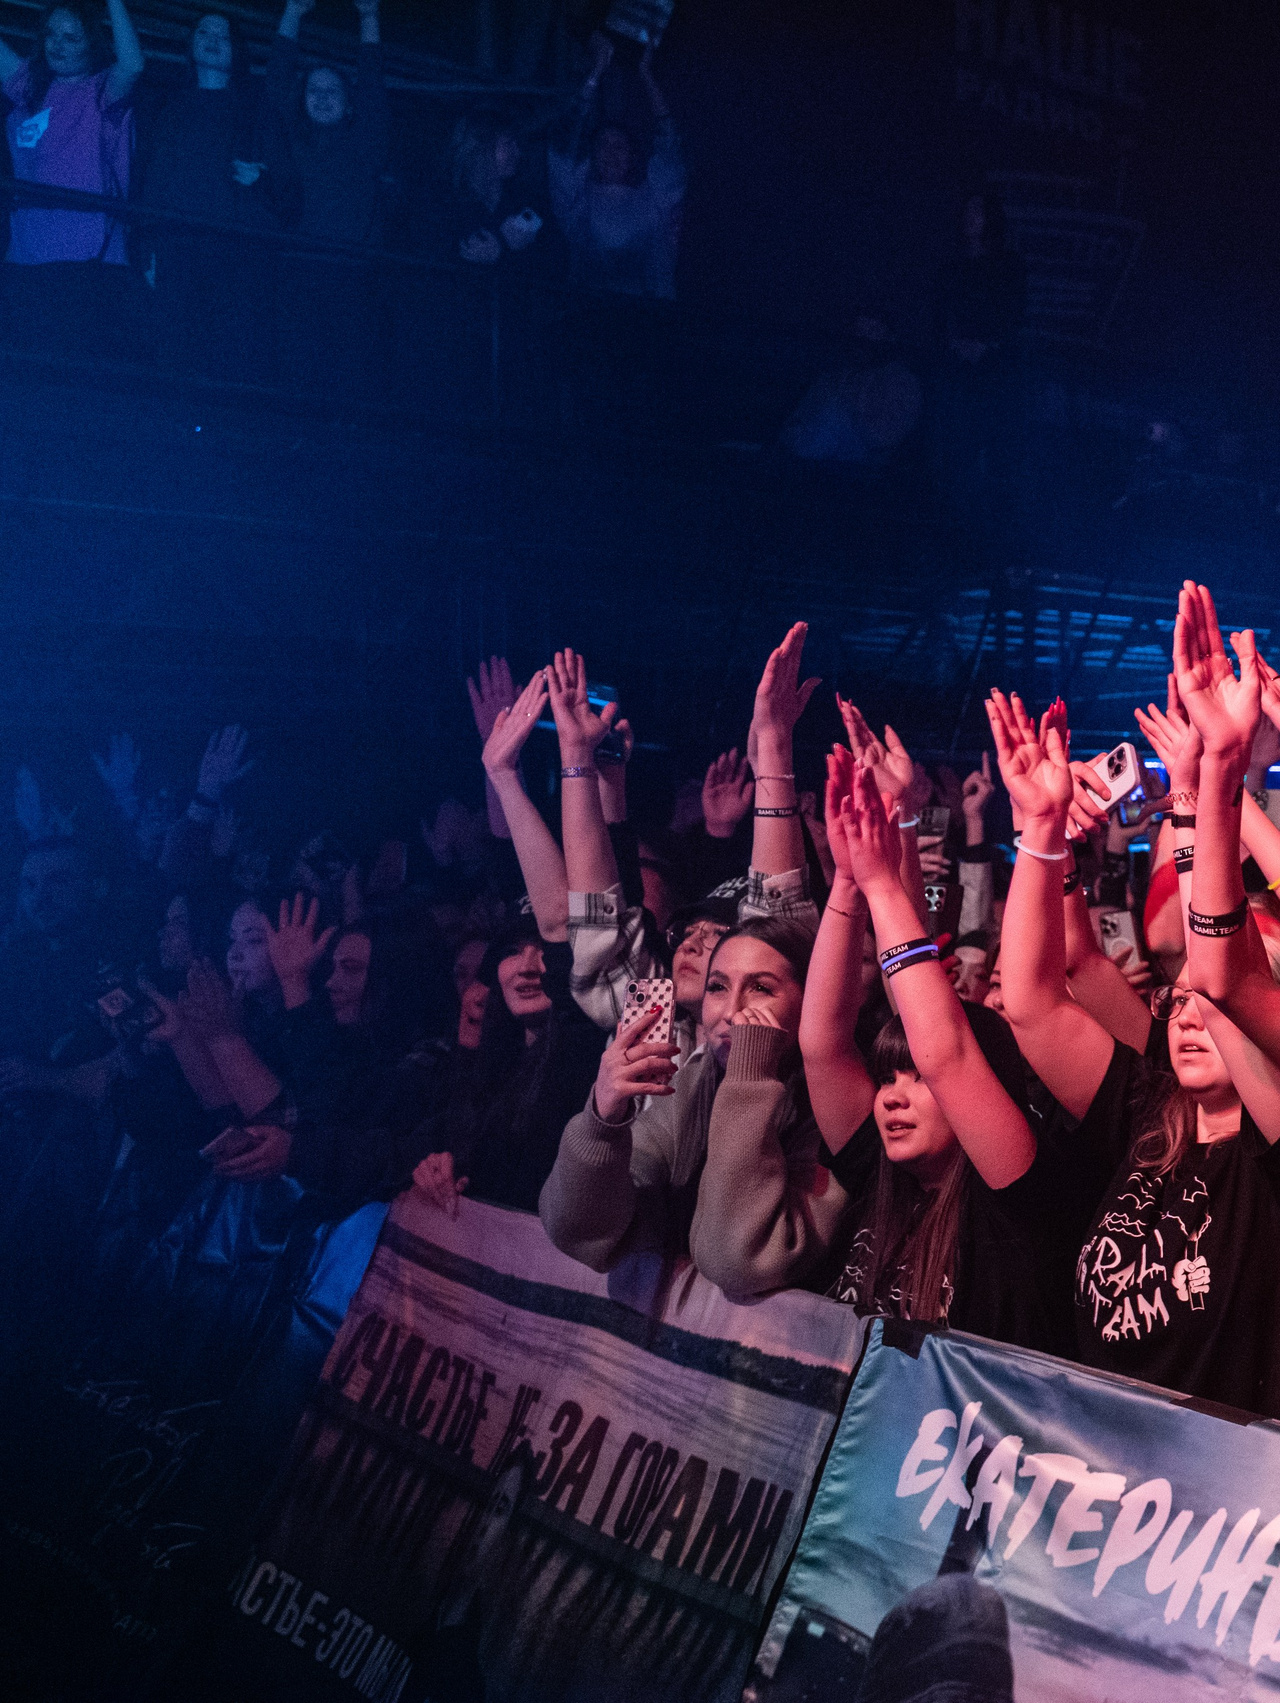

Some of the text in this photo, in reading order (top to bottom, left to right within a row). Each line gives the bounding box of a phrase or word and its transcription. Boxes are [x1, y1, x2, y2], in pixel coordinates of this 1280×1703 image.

[955, 66, 1104, 143] РАДИО
[888, 944, 909, 956] TEAM
[333, 1311, 497, 1460] СЧАСТЬЕ
[531, 1399, 611, 1521] ЗА
[590, 1432, 795, 1600] ГОРАМИ
